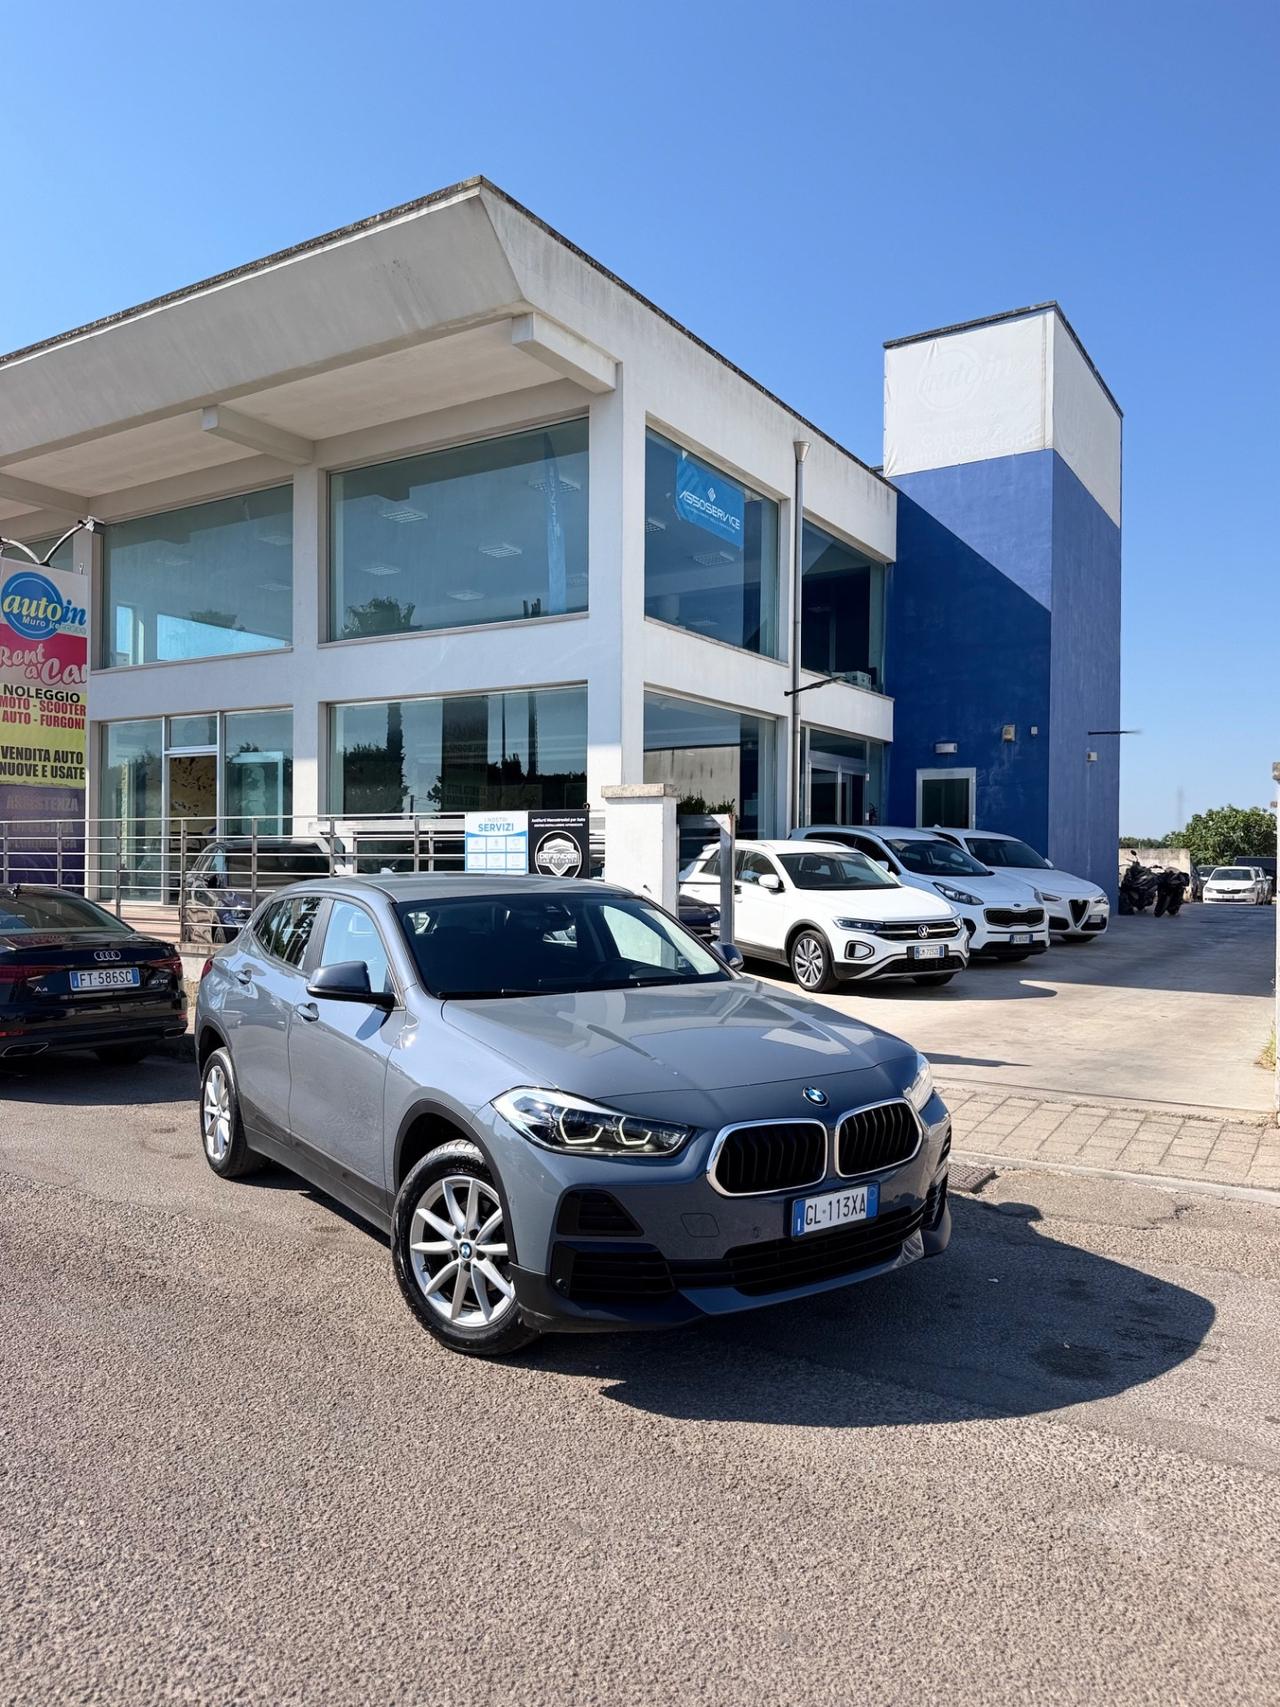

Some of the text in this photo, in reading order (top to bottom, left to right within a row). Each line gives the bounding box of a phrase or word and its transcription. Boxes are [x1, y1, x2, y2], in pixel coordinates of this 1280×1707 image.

[2, 595, 87, 626] autoin
[22, 616, 46, 627] Muro
[0, 643, 45, 667] Rent
[3, 684, 80, 704] NOLEGGIO
[39, 699, 86, 717] SCOOTER
[2, 710, 31, 725] AUTO
[40, 714, 85, 730] FURGONI
[0, 745, 84, 765] VENDITA AUTO
[0, 761, 86, 780] NUOVE E USATE
[478, 823, 514, 832] SERVIZI
